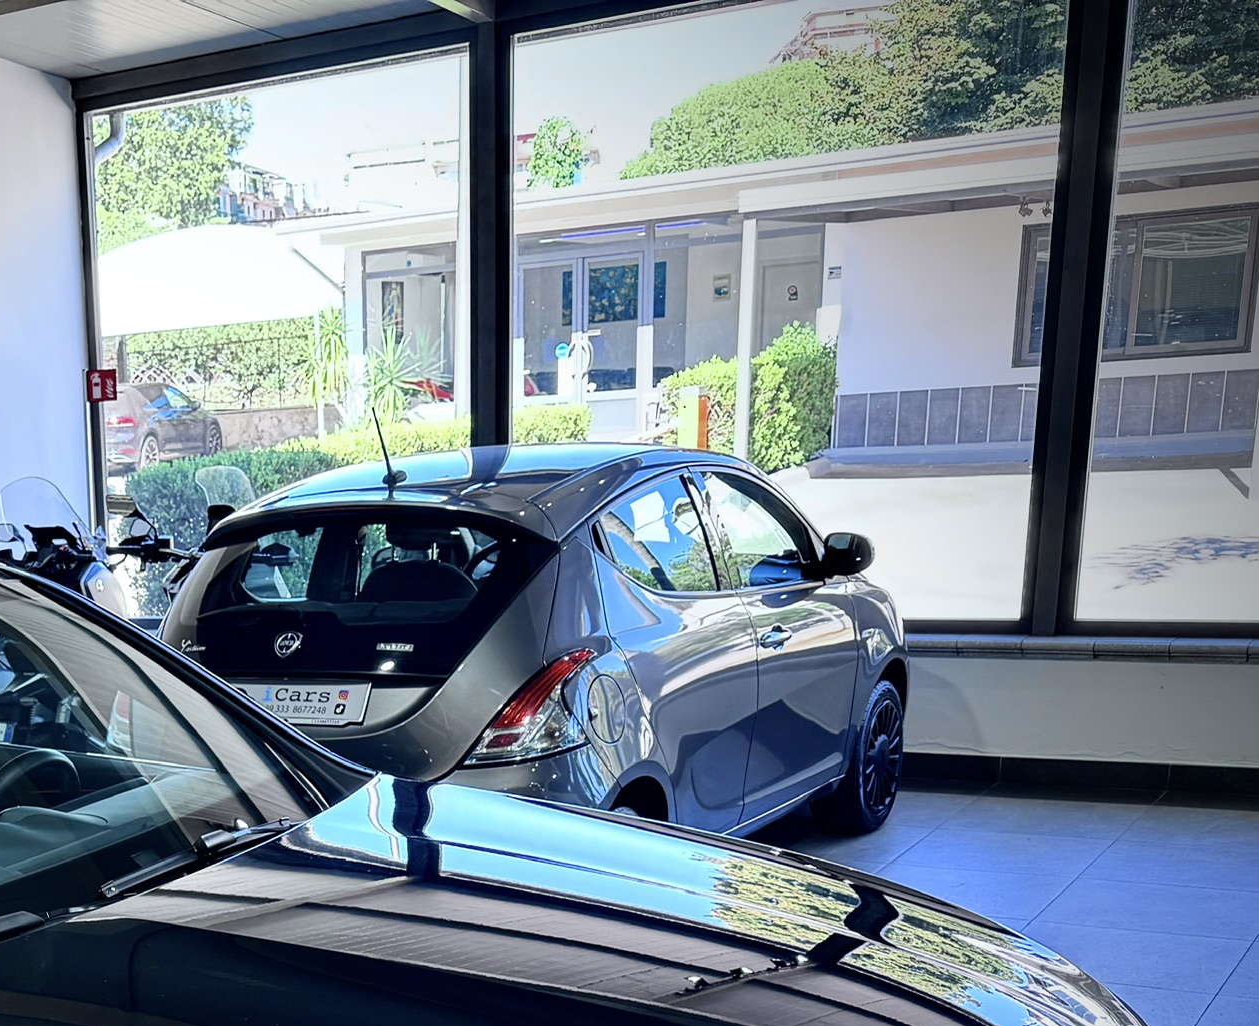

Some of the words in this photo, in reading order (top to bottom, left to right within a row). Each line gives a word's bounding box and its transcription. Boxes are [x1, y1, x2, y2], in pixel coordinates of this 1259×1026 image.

[263, 687, 331, 703] iCars
[275, 705, 289, 713] 333
[292, 706, 327, 714] 8677248
